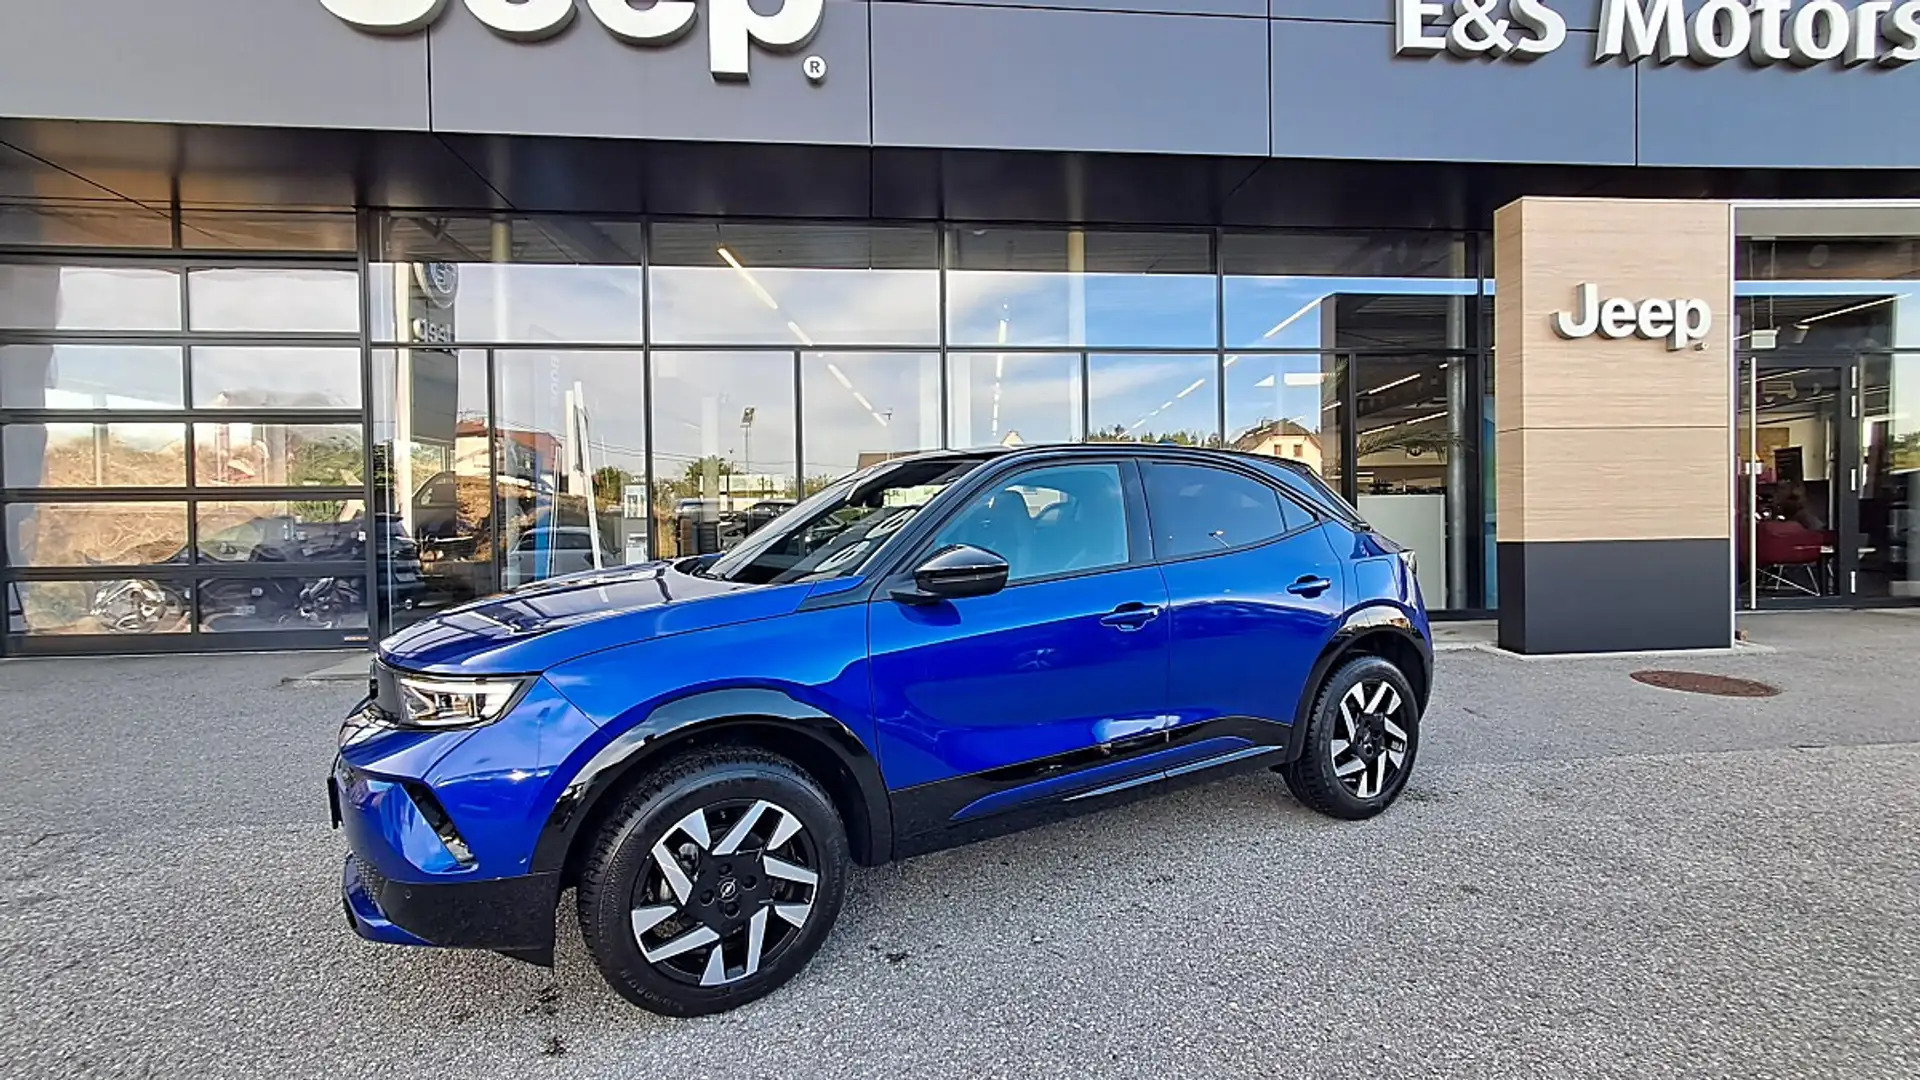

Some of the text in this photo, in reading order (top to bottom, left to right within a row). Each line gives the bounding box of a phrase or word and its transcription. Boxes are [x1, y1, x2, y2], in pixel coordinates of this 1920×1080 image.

[1396, 0, 1920, 65] E&S Motors
[1551, 281, 1712, 351] Jeep
